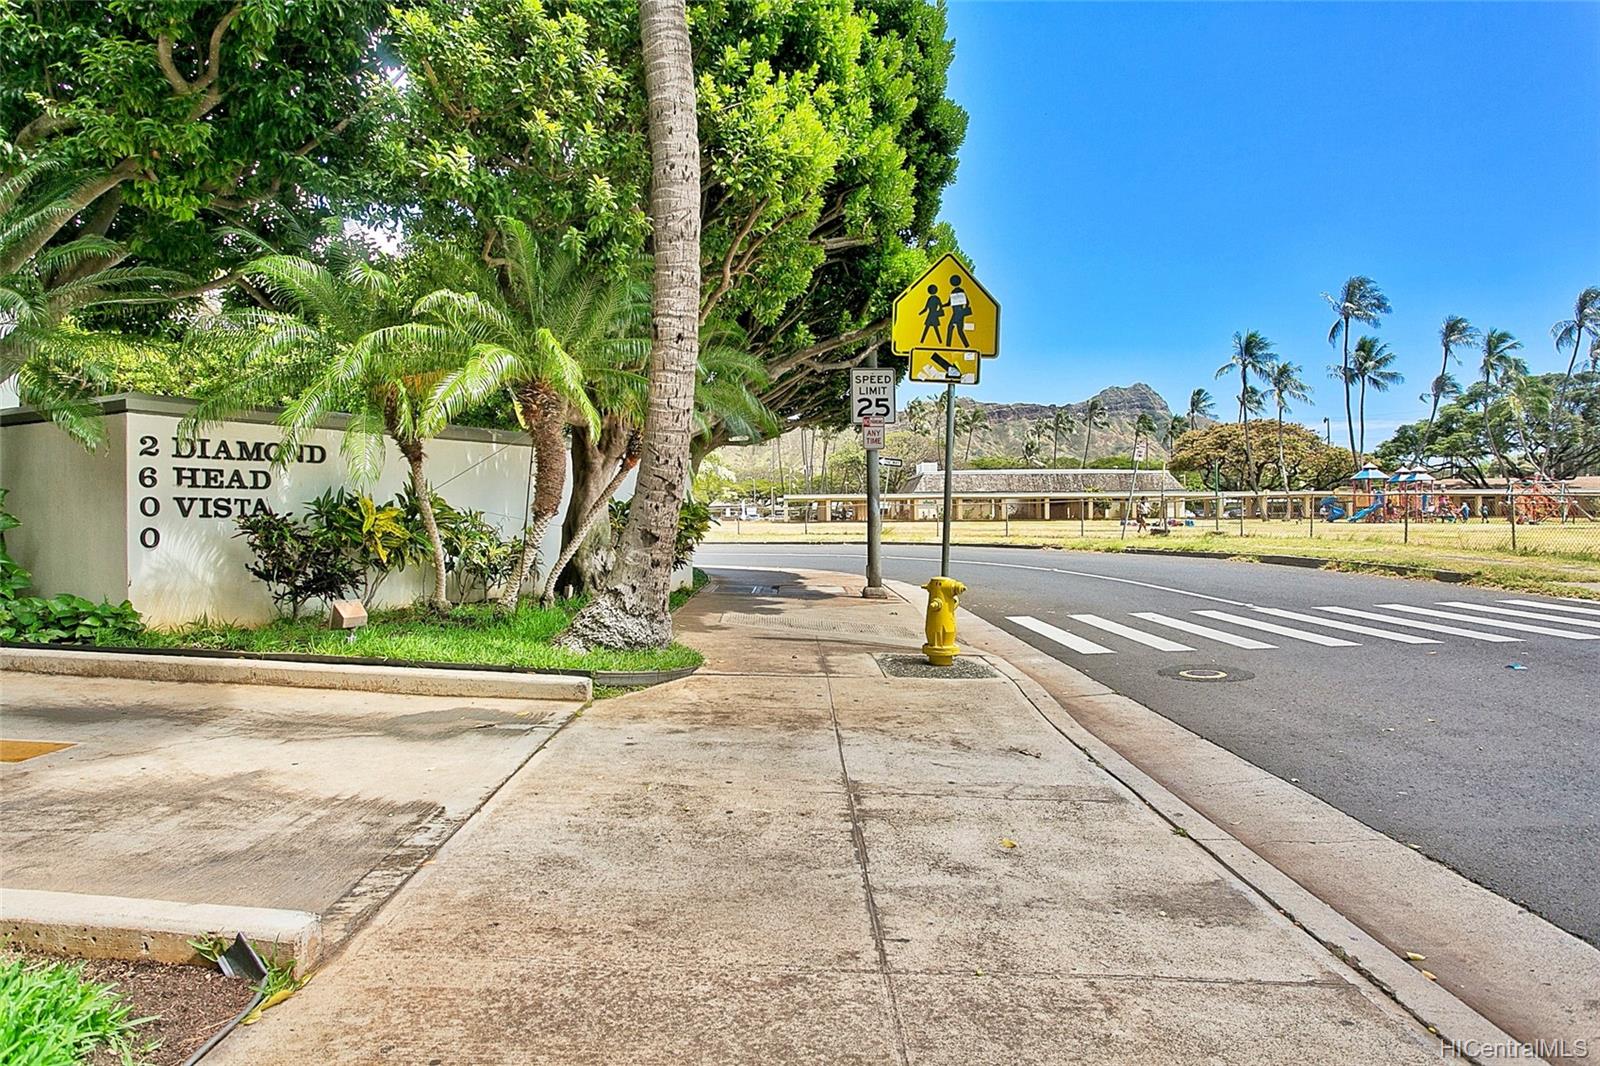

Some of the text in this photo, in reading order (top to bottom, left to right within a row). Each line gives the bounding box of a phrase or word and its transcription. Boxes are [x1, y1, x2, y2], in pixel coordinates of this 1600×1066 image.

[855, 375, 892, 384] SPEED
[859, 386, 887, 395] LIMIT
[857, 397, 890, 417] 25
[866, 437, 881, 445] TIME
[172, 466, 272, 489] HEAD
[172, 497, 273, 519] VISTA
